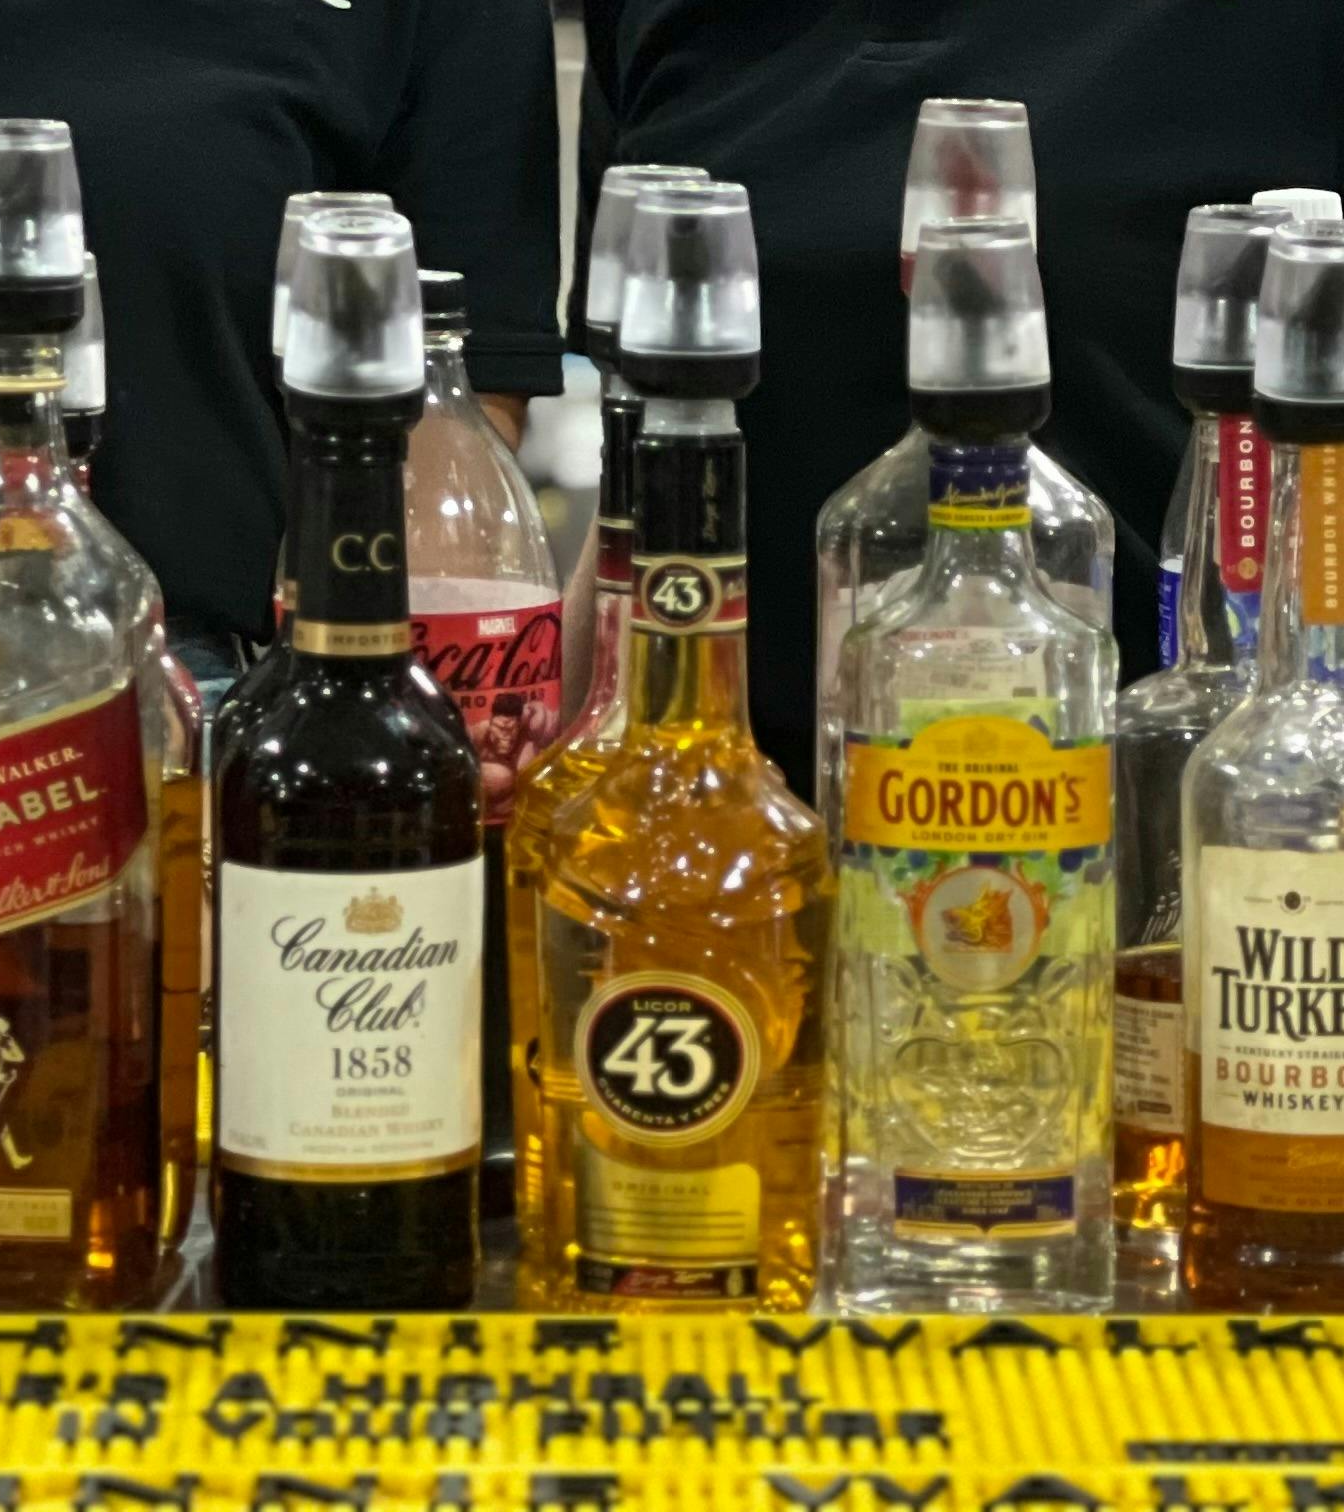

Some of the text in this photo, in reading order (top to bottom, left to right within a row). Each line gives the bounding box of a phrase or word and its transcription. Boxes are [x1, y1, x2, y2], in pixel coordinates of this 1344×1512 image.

[1239, 420, 1255, 548] BOURBON
[1324, 515, 1338, 609] BOURBON
[653, 576, 702, 614] 43
[477, 615, 517, 636] MARVEL
[878, 769, 1082, 827] GORDON'S
[912, 830, 1049, 843] LONDON DRY GIN
[271, 915, 459, 973] Canadian
[632, 999, 692, 1014] LICOR
[331, 1044, 413, 1080] 1858
[602, 1016, 714, 1098] 43
[1235, 1045, 1294, 1059] KENTUCKY
